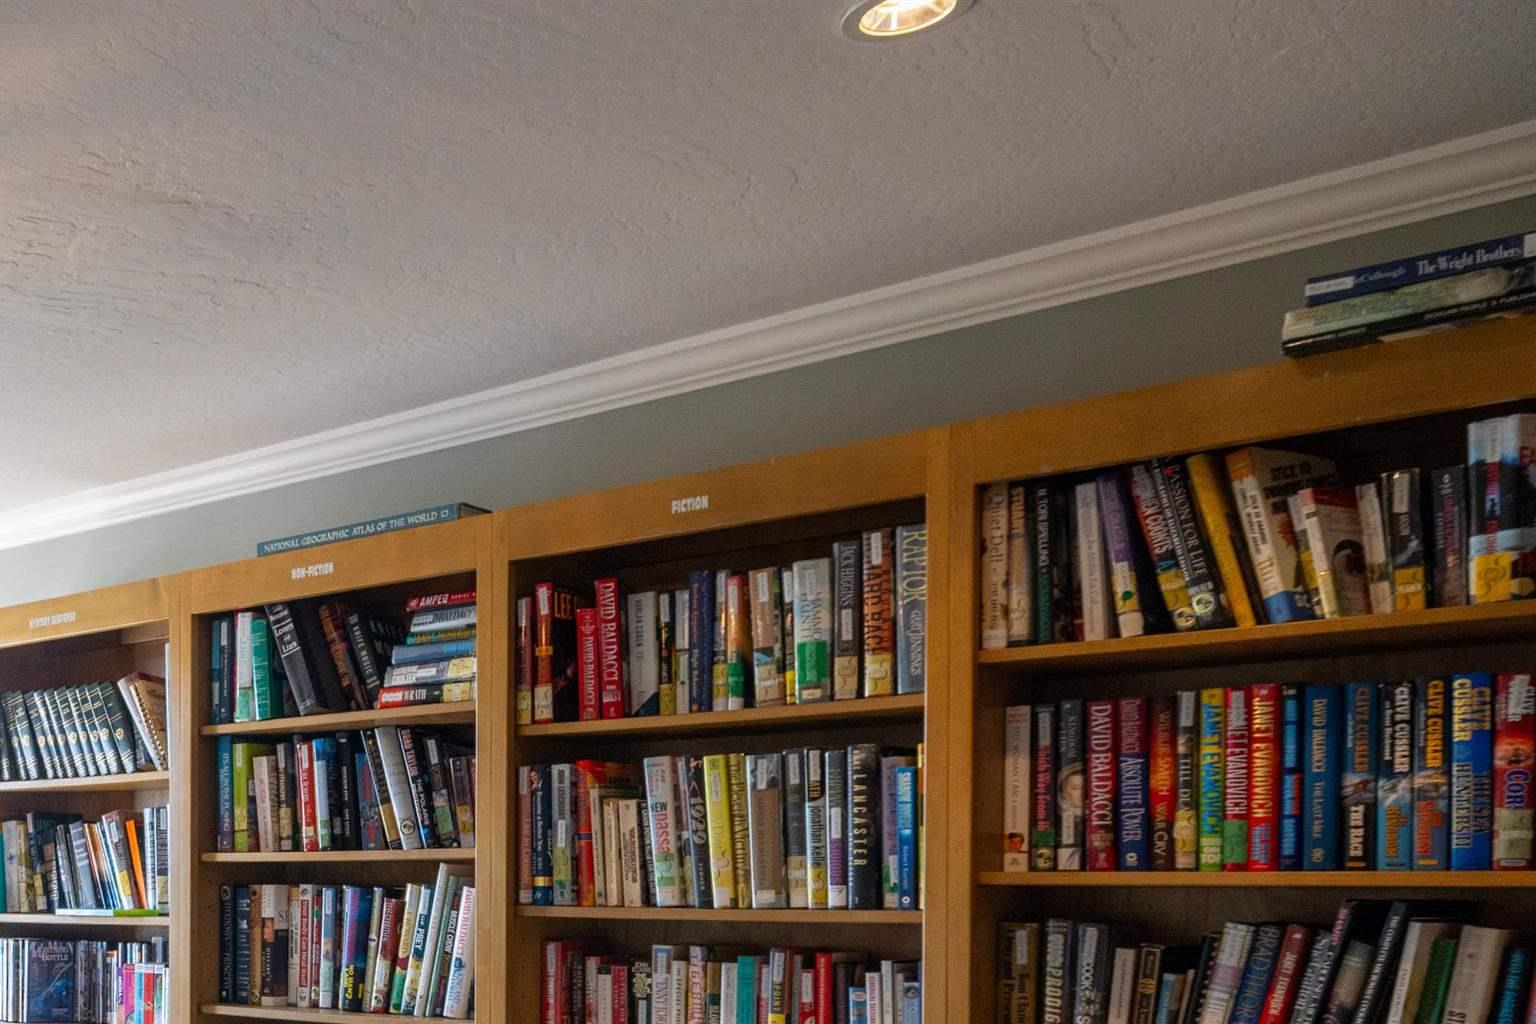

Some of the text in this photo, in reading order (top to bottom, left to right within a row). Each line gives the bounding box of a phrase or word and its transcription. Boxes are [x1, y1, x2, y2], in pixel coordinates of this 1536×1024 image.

[1417, 245, 1522, 275] The Wright Brothers
[672, 495, 709, 514] FICTION
[264, 511, 438, 552] NATIONAL GEOGRAPHIC ATLAS OF THE WORLD
[988, 492, 1005, 563] Quiet Dell
[1039, 523, 1050, 566] SPELLING
[1182, 523, 1201, 547] FOR
[291, 562, 334, 580] NON-FICTION
[840, 545, 856, 606] JACK HIGGINS
[903, 531, 927, 604] RAPTOR
[1190, 550, 1208, 576] LIFE
[420, 594, 449, 606] AMPED
[555, 592, 572, 618] LEE
[274, 622, 295, 636] Lovers
[352, 625, 365, 650] KNIFE
[600, 582, 618, 681] DAVID BALDACCI
[634, 599, 644, 647] HARLAN COBEN
[908, 610, 923, 676] GARY JENNINGS
[282, 641, 298, 652] Liars
[583, 636, 594, 705] DAVID BALDACCI
[1312, 698, 1328, 726] DAVID
[1354, 687, 1370, 772] CLIVE CUSSLER
[1392, 687, 1411, 773] CLIVE CUSSLER
[1425, 680, 1444, 768] CLIVE CUSSLER
[1452, 678, 1472, 742] CUSSLER
[1472, 687, 1491, 730] CLIVE
[401, 729, 417, 777] BRAD TAYLOR
[1090, 705, 1112, 825] DAVID BALDACCI
[1179, 758, 1192, 782] TILL
[1202, 704, 1222, 835] JANET EVANOVICH
[1252, 697, 1274, 817] JANET EVANOVICH
[1312, 729, 1328, 772] BALDACCI
[1158, 758, 1171, 795] SMITH
[1226, 748, 1249, 814] EVANOVICH
[690, 795, 707, 844] 1929
[853, 774, 867, 866] LANCASTER
[1120, 757, 1144, 842] ABSOLUTE POWER
[1154, 802, 1167, 829] WAR
[1473, 805, 1490, 834] SEA
[808, 805, 825, 843] jonathan
[1154, 831, 1168, 856] CRY
[1349, 804, 1365, 856] THE RACE
[301, 935, 309, 949] Can
[414, 928, 424, 950] PREY
[446, 910, 458, 934] MUSCLE
[456, 889, 473, 956] DAVID BALDACCI
[42, 953, 69, 961] BOTTLE
[300, 950, 309, 966] Heal
[1254, 927, 1278, 970] BRAD
[300, 967, 309, 986] Itself
[1268, 952, 1298, 1016] JANET EVANOVICH
